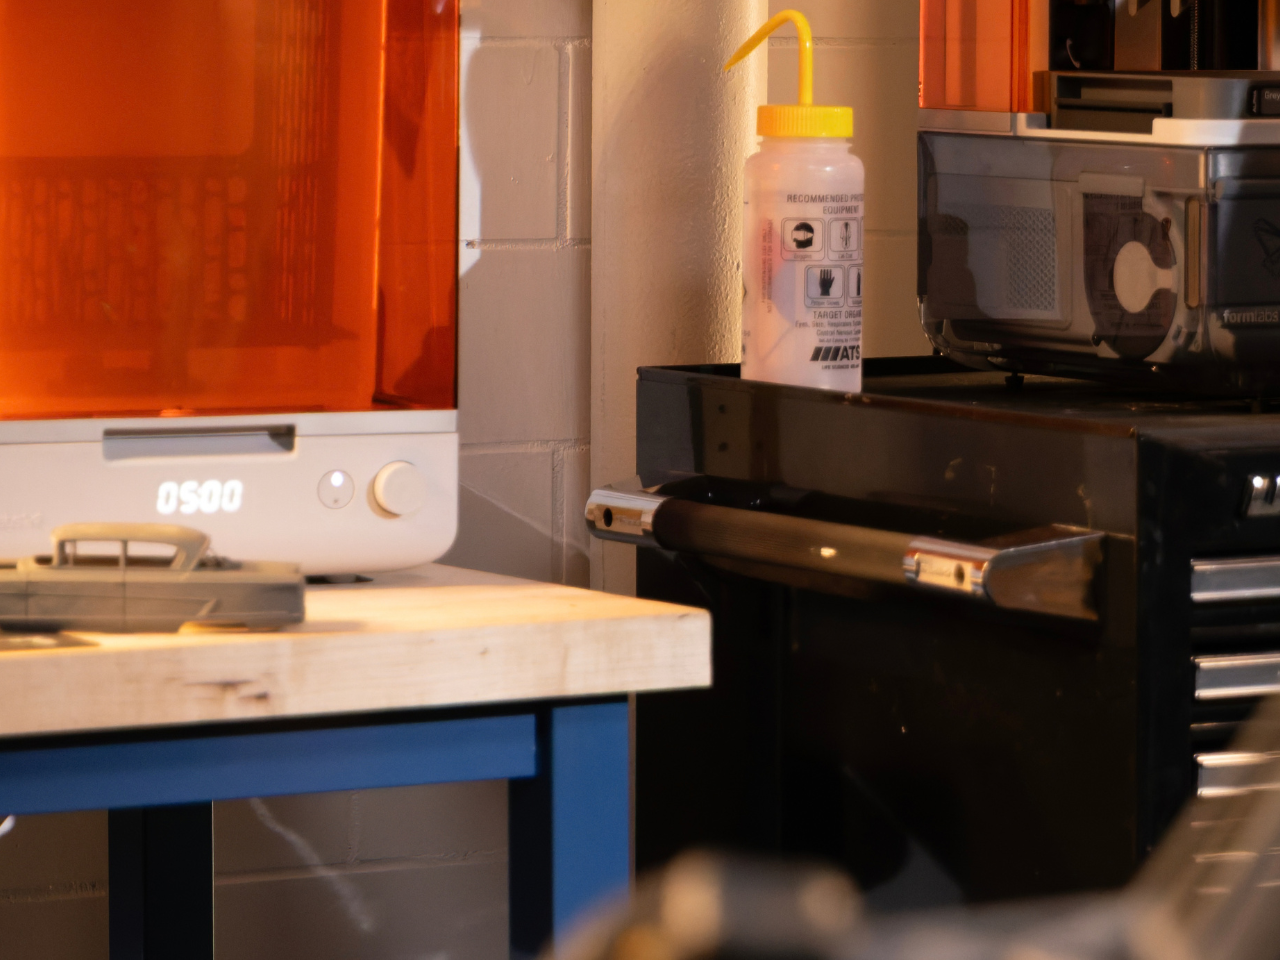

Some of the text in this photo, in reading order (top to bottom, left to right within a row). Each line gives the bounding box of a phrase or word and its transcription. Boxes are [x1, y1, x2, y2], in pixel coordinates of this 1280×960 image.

[1264, 91, 1280, 101] Grey
[786, 194, 849, 203] RECOMMENDED
[823, 205, 859, 214] EQUIPMENT
[813, 311, 843, 319] TARGET
[1223, 309, 1279, 323] formlabs
[840, 345, 860, 361] ATS
